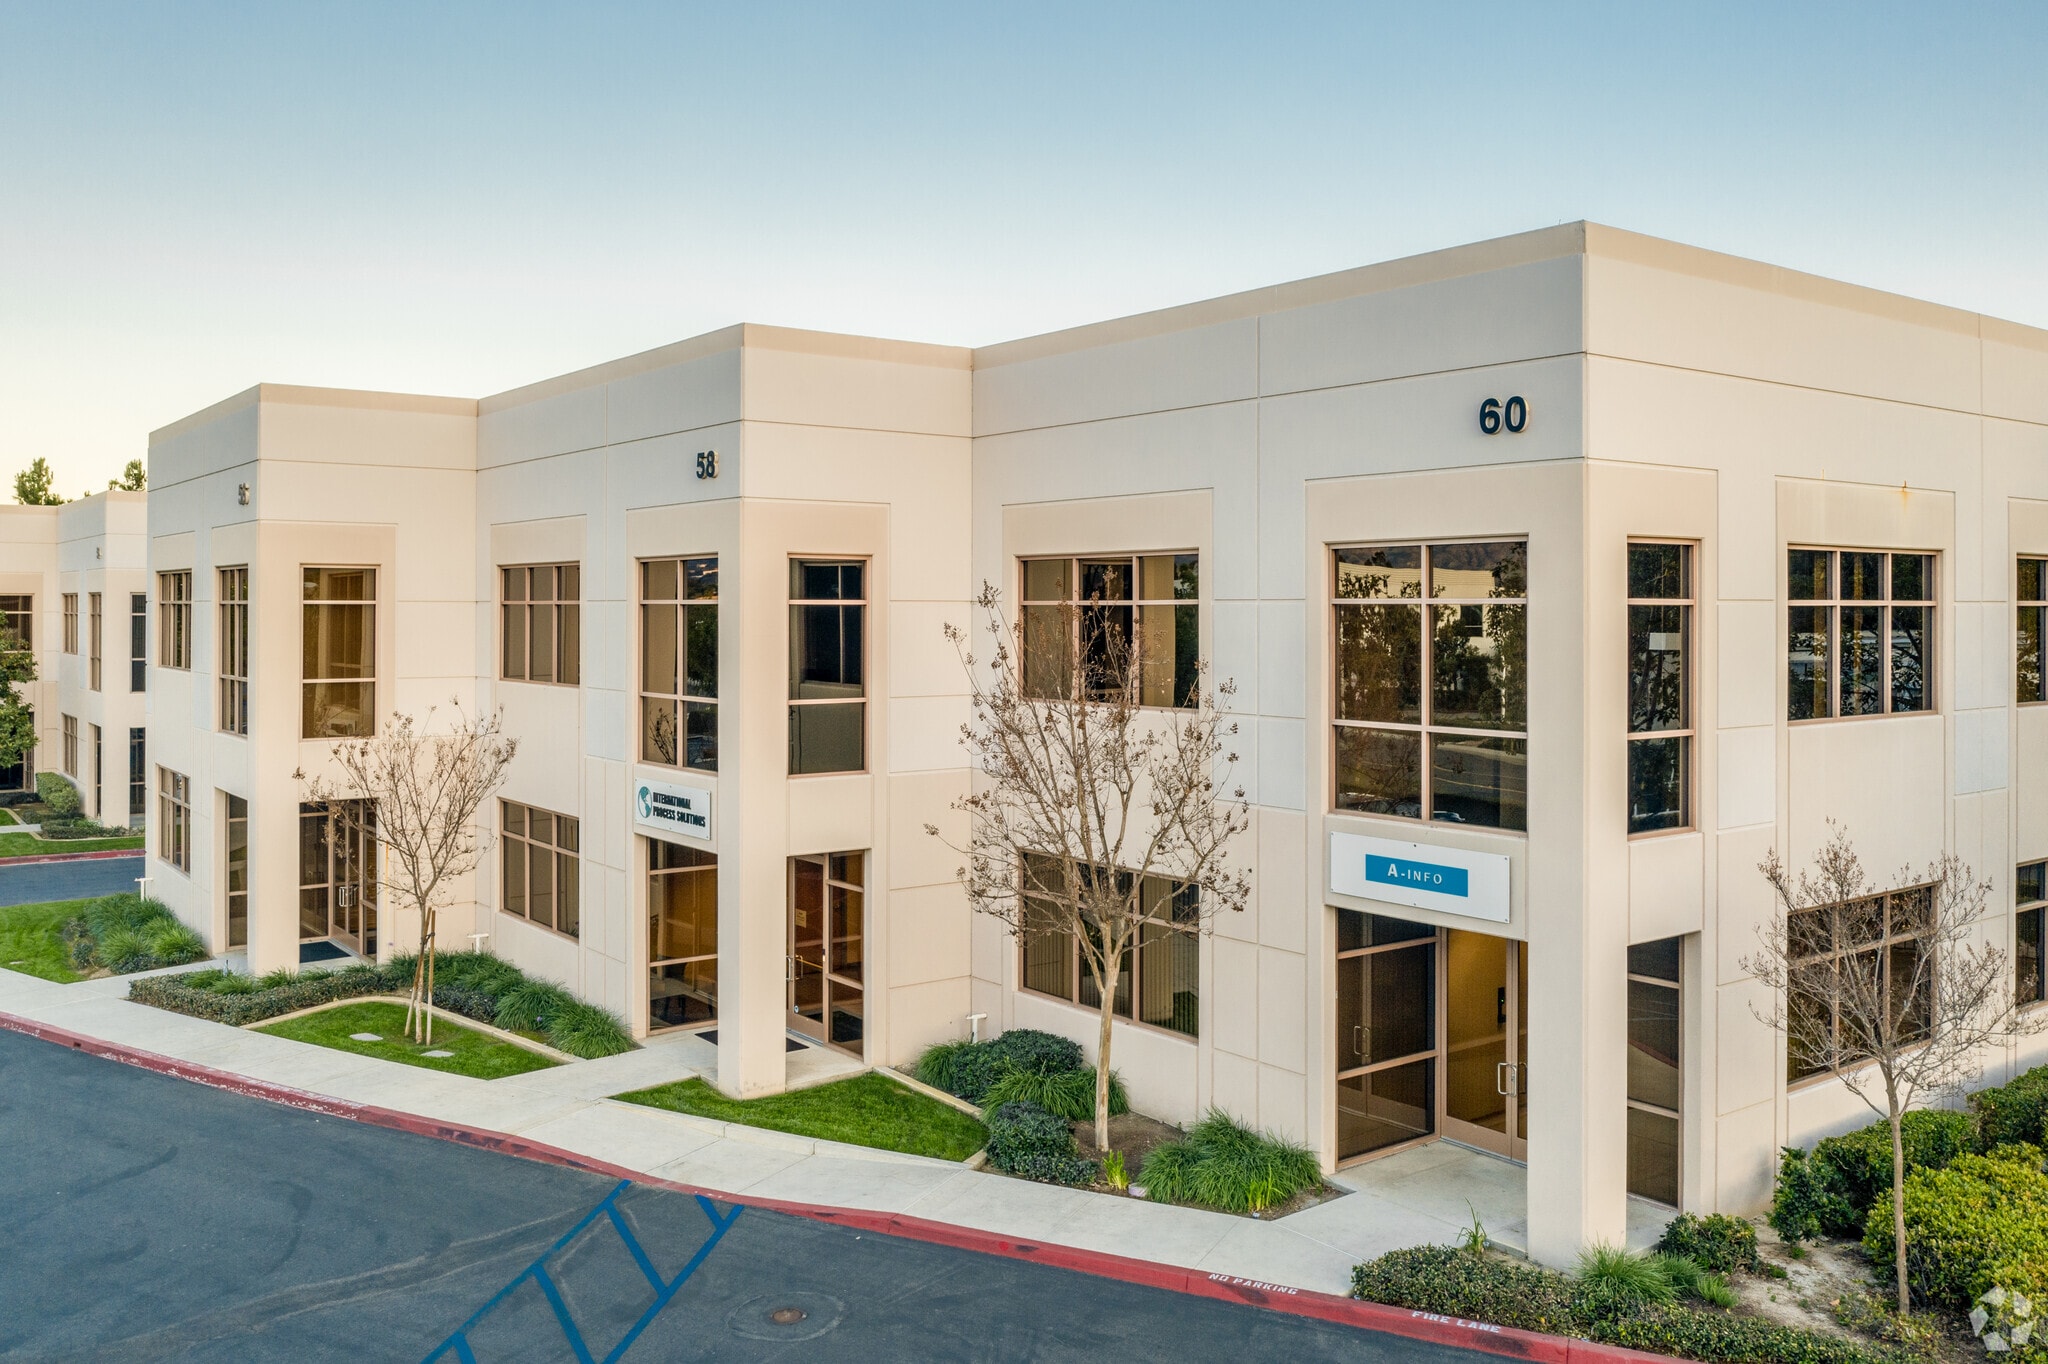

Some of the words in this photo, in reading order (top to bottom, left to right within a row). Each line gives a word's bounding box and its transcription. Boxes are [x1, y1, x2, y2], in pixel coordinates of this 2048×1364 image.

[1479, 395, 1527, 434] 60
[696, 450, 717, 479] 58
[653, 791, 692, 810] INTERNATIONAL
[653, 805, 676, 821] PROCESS
[677, 810, 706, 828] SOLUTIONS
[1387, 863, 1443, 885] A-INFO
[1208, 1273, 1230, 1282] NO
[1232, 1277, 1299, 1295] PARKING
[1411, 1310, 1451, 1324] FIRE
[1456, 1318, 1502, 1333] LANE
